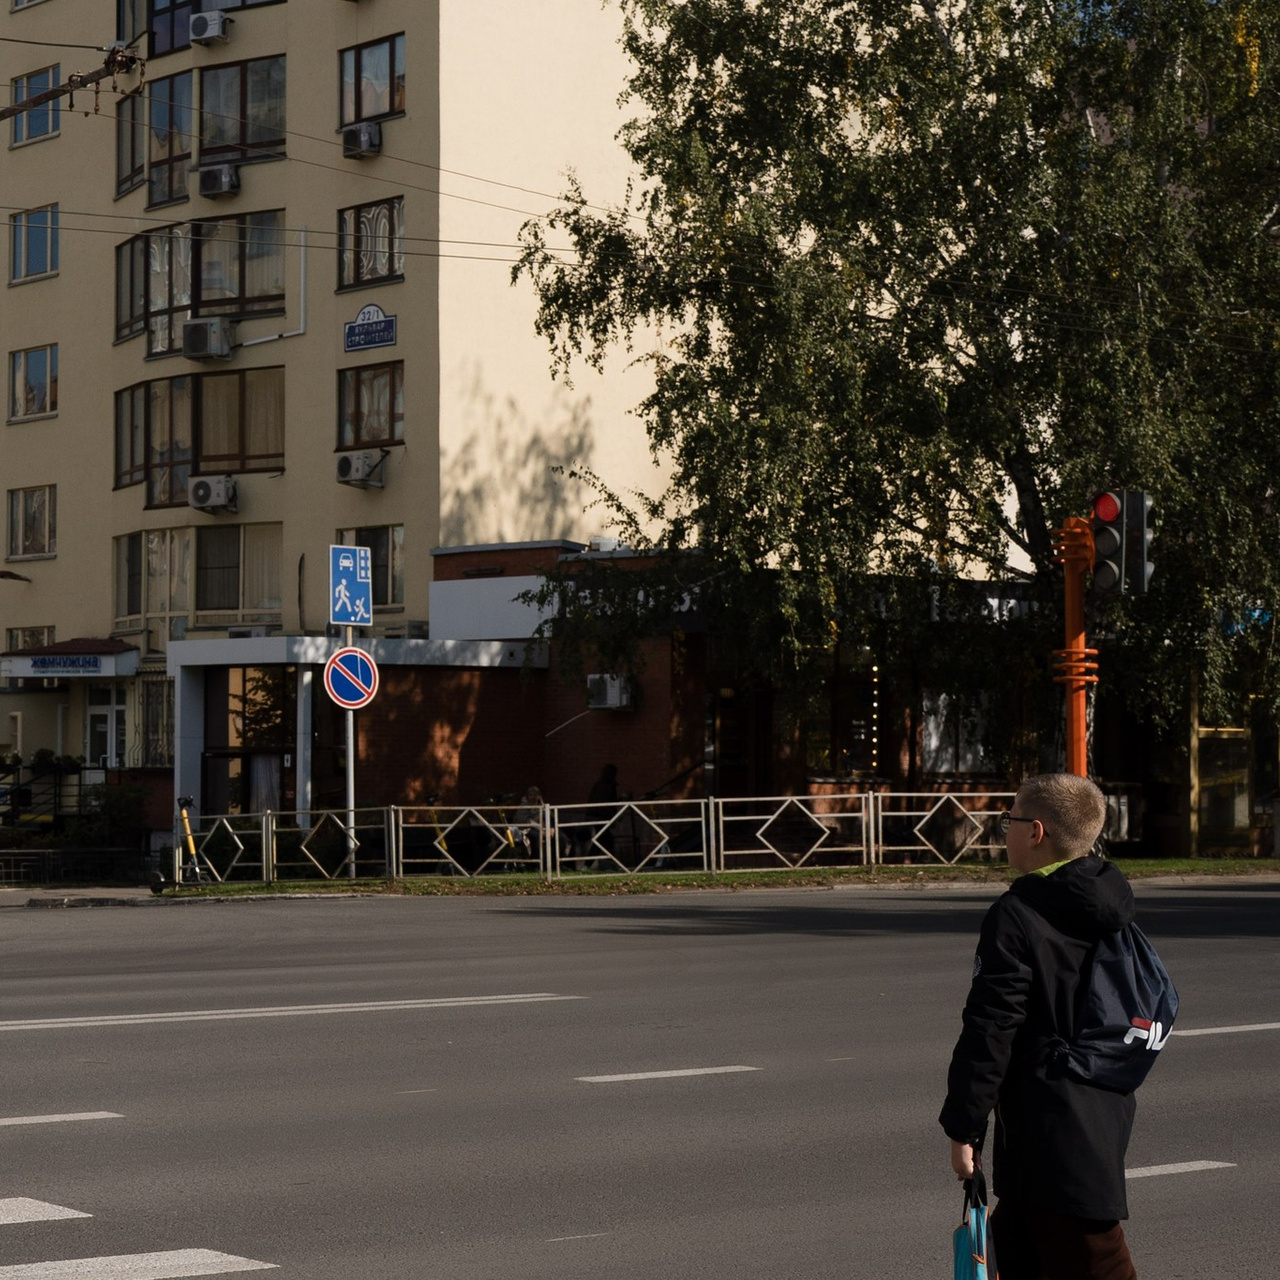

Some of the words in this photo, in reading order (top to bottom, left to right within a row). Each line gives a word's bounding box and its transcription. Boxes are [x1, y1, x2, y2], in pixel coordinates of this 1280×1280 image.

[361, 309, 380, 322] 32/1
[354, 322, 385, 335] БУЛЬВАР
[348, 329, 394, 346] СТРОИТЕЛЕЙ
